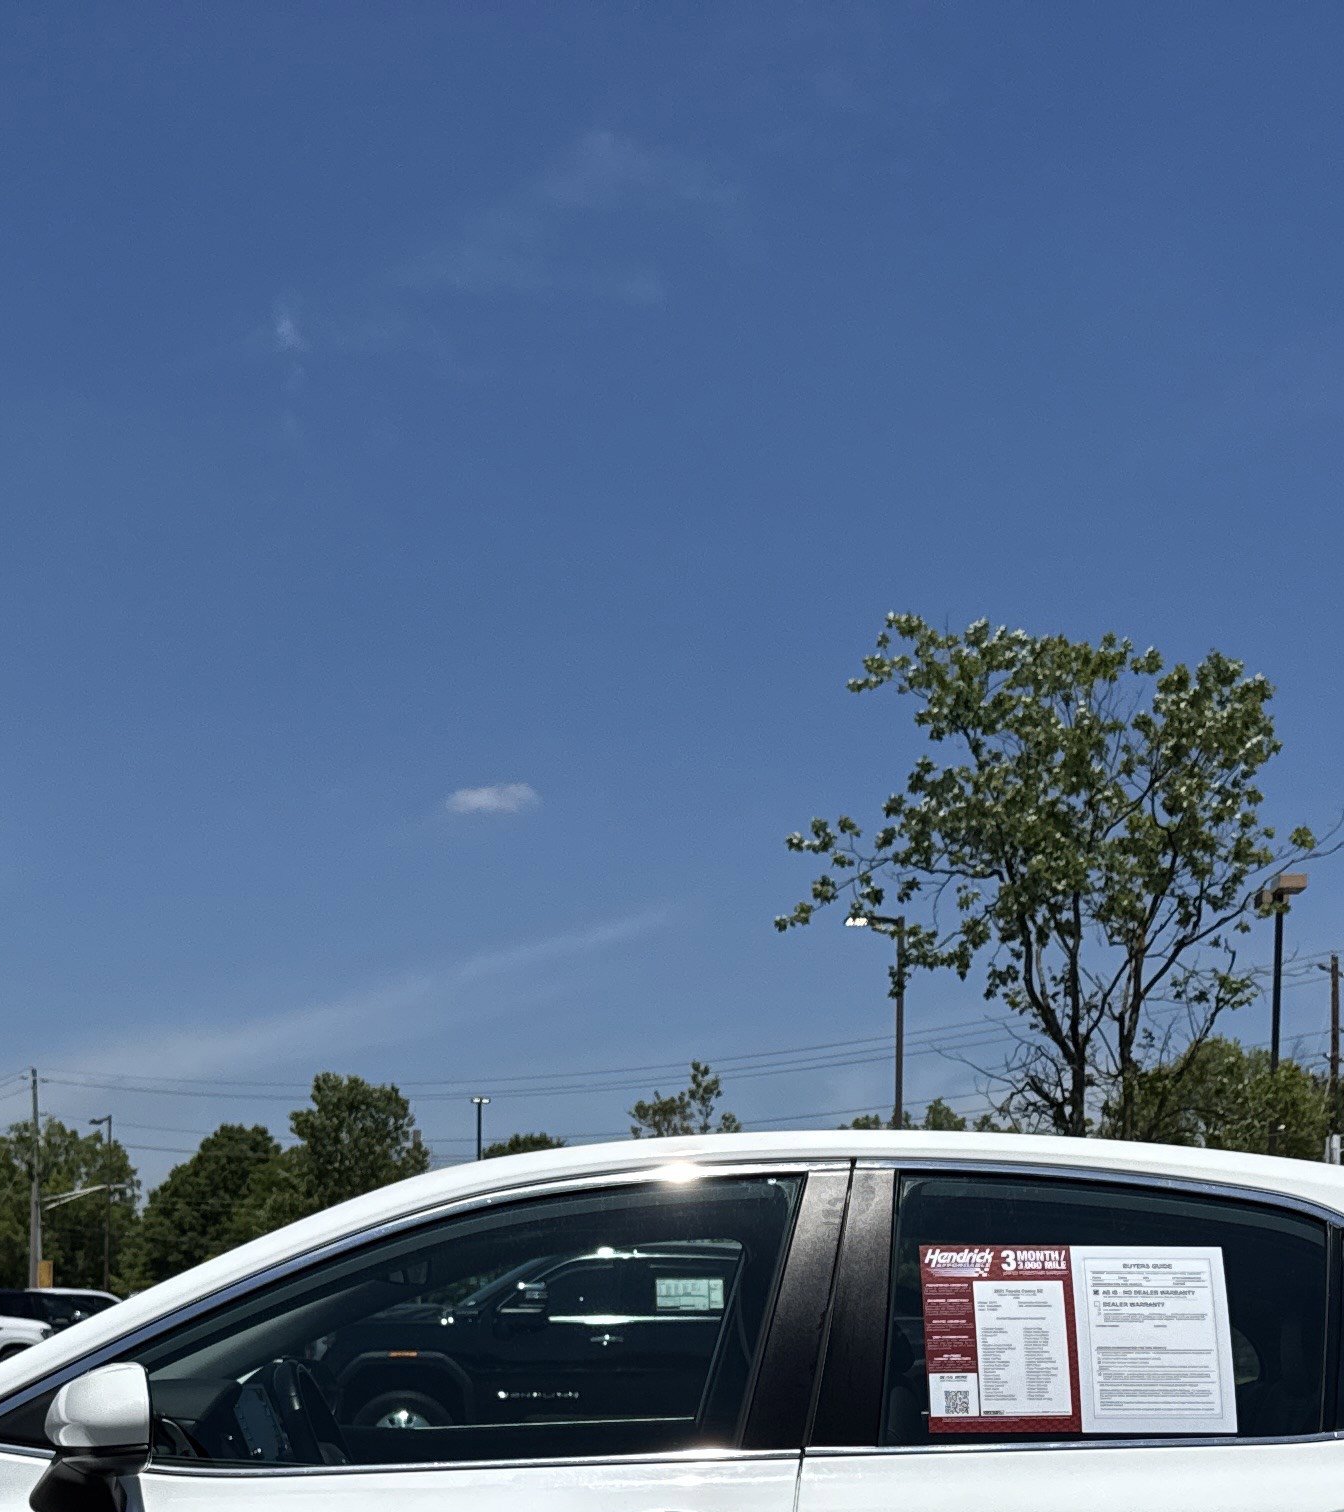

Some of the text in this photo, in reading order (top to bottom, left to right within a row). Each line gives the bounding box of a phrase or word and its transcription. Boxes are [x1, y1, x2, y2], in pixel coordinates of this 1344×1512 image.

[924, 1248, 994, 1267] Hendrick
[1001, 1250, 1065, 1270] 3 MONTH/
[1017, 1261, 1066, 1270] 3,000 MILE
